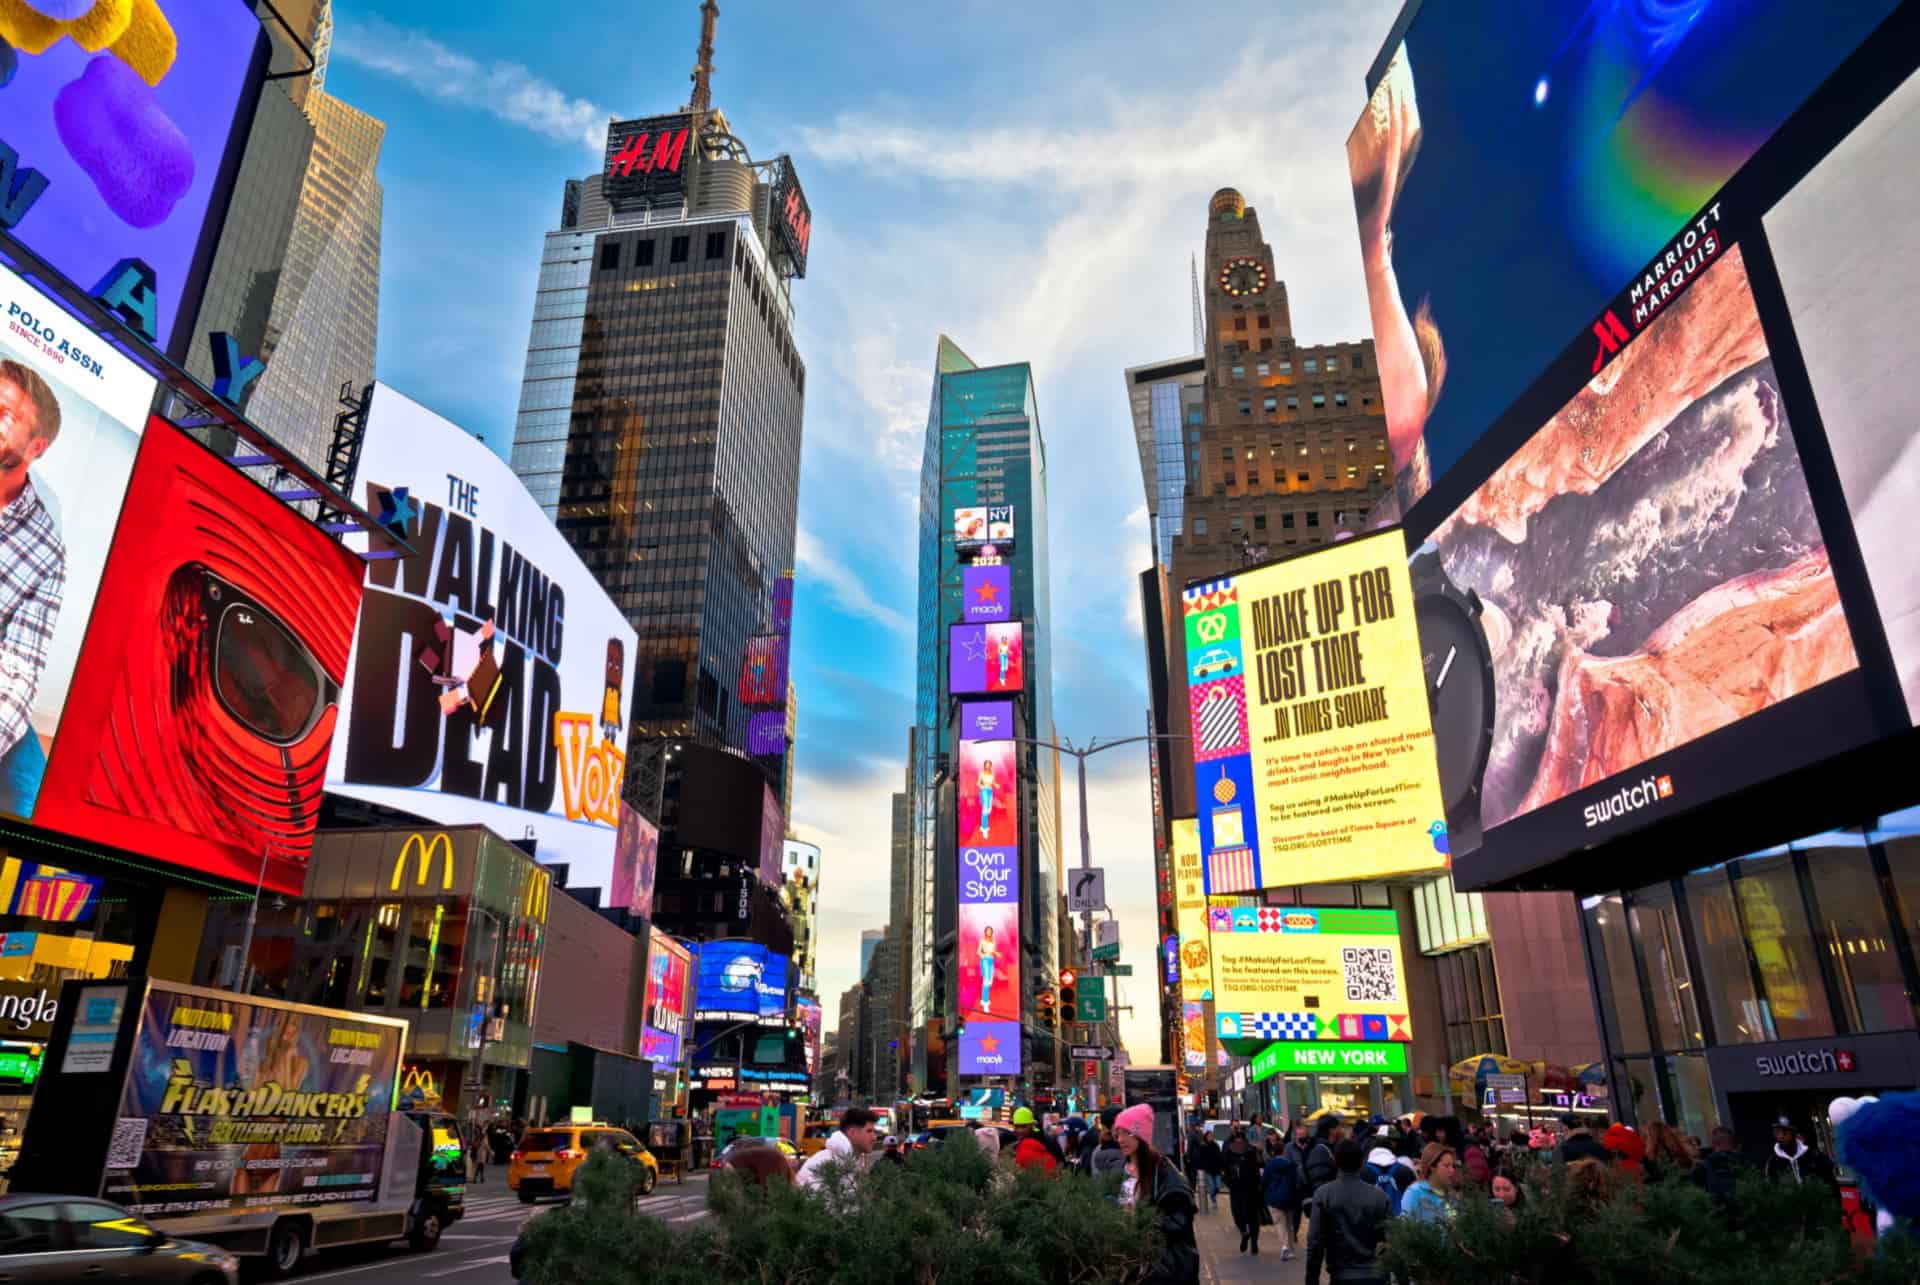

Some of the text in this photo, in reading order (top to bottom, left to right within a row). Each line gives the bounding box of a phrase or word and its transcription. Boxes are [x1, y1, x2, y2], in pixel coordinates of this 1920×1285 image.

[1630, 202, 1721, 304] MARRIOTT
[1635, 237, 1717, 324] MARQUIS
[8, 301, 104, 380] POLO ASSN.
[9, 321, 65, 364] SINCE 1890
[446, 474, 479, 518] THE
[366, 480, 565, 668] WALKING
[1251, 566, 1395, 651] MAKE UP FOR
[1256, 631, 1366, 705] LOST TIME
[345, 586, 562, 815] DEAD
[1292, 698, 1334, 737] TIMES
[1335, 686, 1389, 728] SQUARE
[1266, 744, 1414, 778] drinks, and laughs in New York's
[1281, 753, 1300, 762] time
[1303, 751, 1312, 760] to
[1314, 745, 1340, 758] catch
[1341, 743, 1354, 754] up
[1356, 741, 1368, 750] on
[1370, 734, 1404, 748] shared
[1267, 760, 1390, 788] most iconic neighborhood.
[1269, 782, 1421, 813] Tag us using #MakeUpForLostTime
[1270, 797, 1397, 823] to be featured on this screen.
[1583, 778, 1658, 828] swatch
[1272, 832, 1305, 844] Discover
[1306, 829, 1319, 839] the
[1320, 827, 1338, 838] best
[1340, 825, 1349, 834] of
[1350, 822, 1374, 834] Times
[1375, 819, 1406, 831] Square
[1273, 835, 1352, 853] TSQ.ORG/LOSTTIME
[964, 848, 1004, 867] Own
[976, 864, 1011, 882] Your
[738, 879, 749, 919] 1500
[965, 880, 1007, 902] Style
[166, 1029, 232, 1051] LOCATION
[1295, 1050, 1388, 1065] NEW YORK
[1756, 1049, 1837, 1076] swatch
